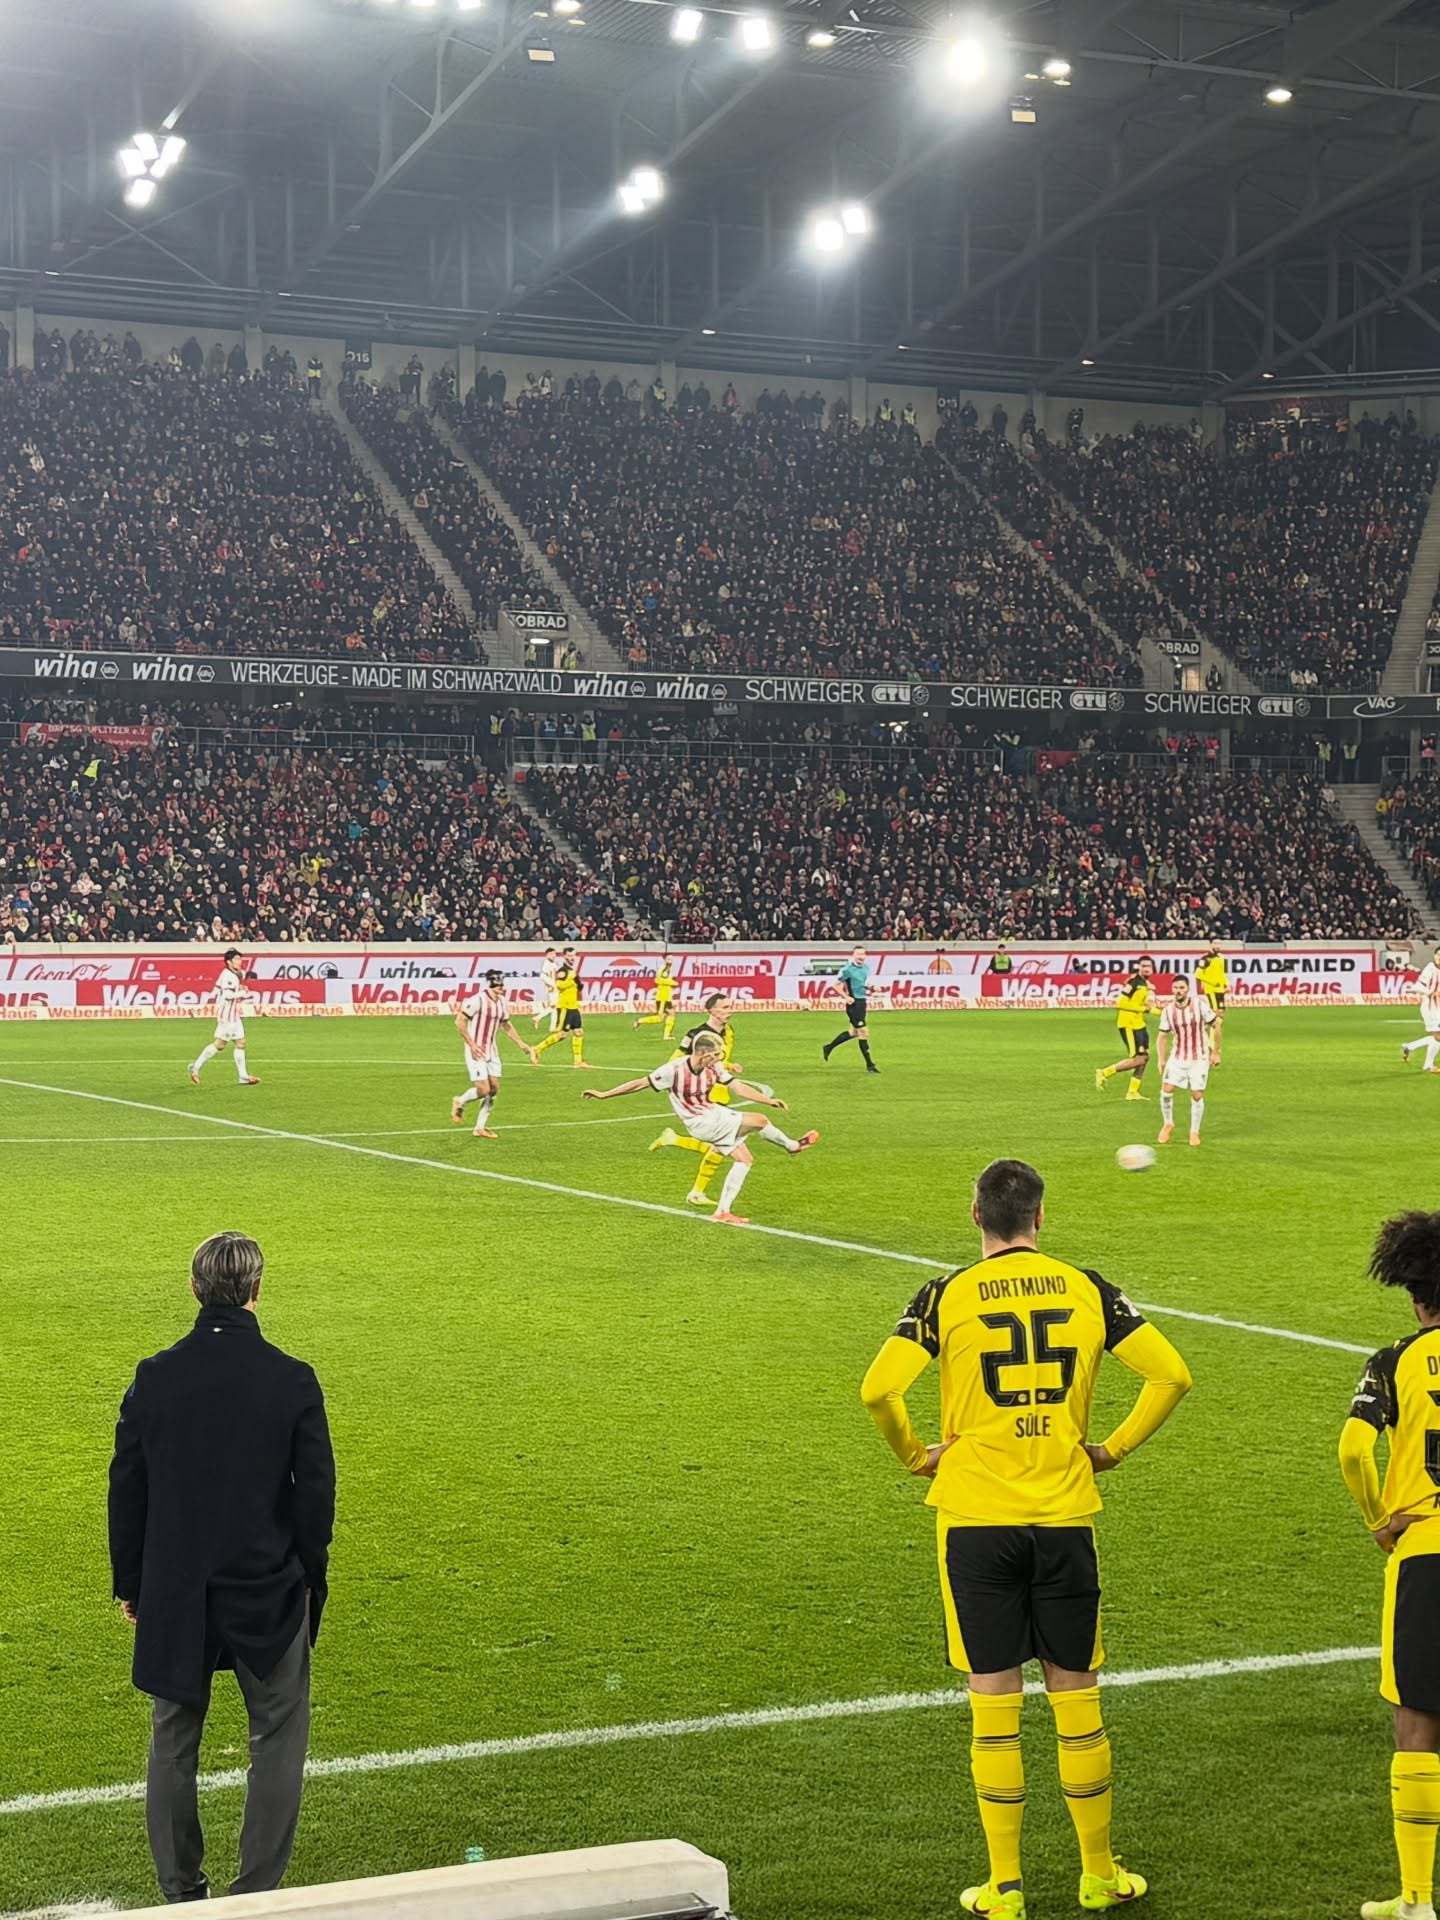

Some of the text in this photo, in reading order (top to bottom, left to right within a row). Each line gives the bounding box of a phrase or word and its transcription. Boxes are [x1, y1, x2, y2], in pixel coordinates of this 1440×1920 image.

[34, 653, 98, 678] wiha
[132, 656, 194, 681] wiha
[230, 661, 339, 685] WERKZEUGE
[352, 667, 402, 688] MADE
[407, 669, 426, 689] IM
[432, 669, 562, 693] SCHWARZWALD
[574, 672, 628, 696] wiha
[656, 676, 709, 699] wiha
[745, 679, 865, 703] SCHWEIGER
[950, 686, 1063, 710] SCHWEIGER
[1367, 696, 1396, 709] VAG
[1144, 693, 1252, 716] SCHWEIGER
[274, 964, 315, 979] AOK
[102, 984, 301, 1006] Weberaus
[352, 983, 534, 1002] WeberHus
[48, 1006, 142, 1018] WeberHaus
[353, 1004, 440, 1015] WeberHaus
[978, 1276, 1067, 1302] DORTMUND
[978, 1308, 1078, 1407] 25
[1015, 1413, 1051, 1438] SÜLE
